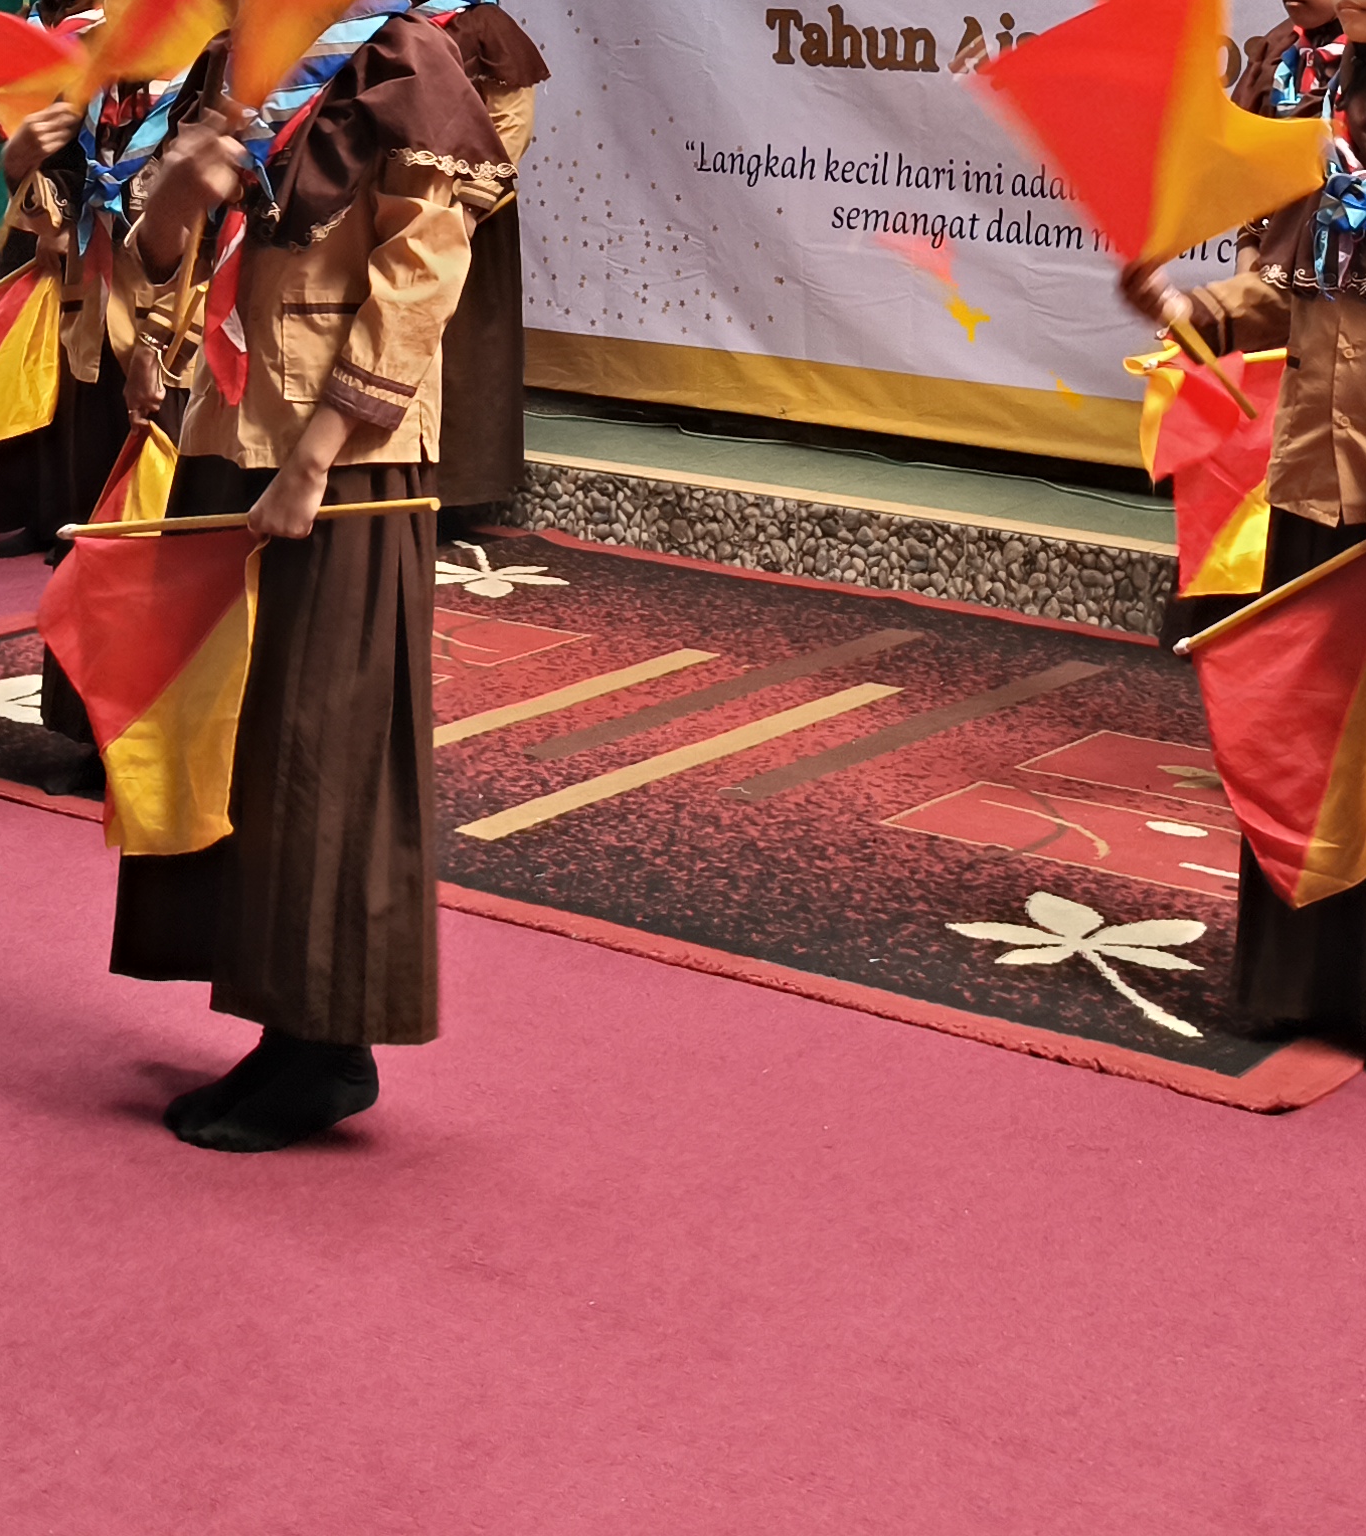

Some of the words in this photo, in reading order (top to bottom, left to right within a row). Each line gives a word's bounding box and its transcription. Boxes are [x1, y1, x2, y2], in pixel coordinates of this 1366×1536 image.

[765, 4, 940, 73] Tahun
[824, 147, 888, 186] kecil
[896, 152, 957, 192] hari
[963, 159, 1005, 196] ini
[831, 205, 980, 250] semangat
[986, 207, 1085, 252] dalam
